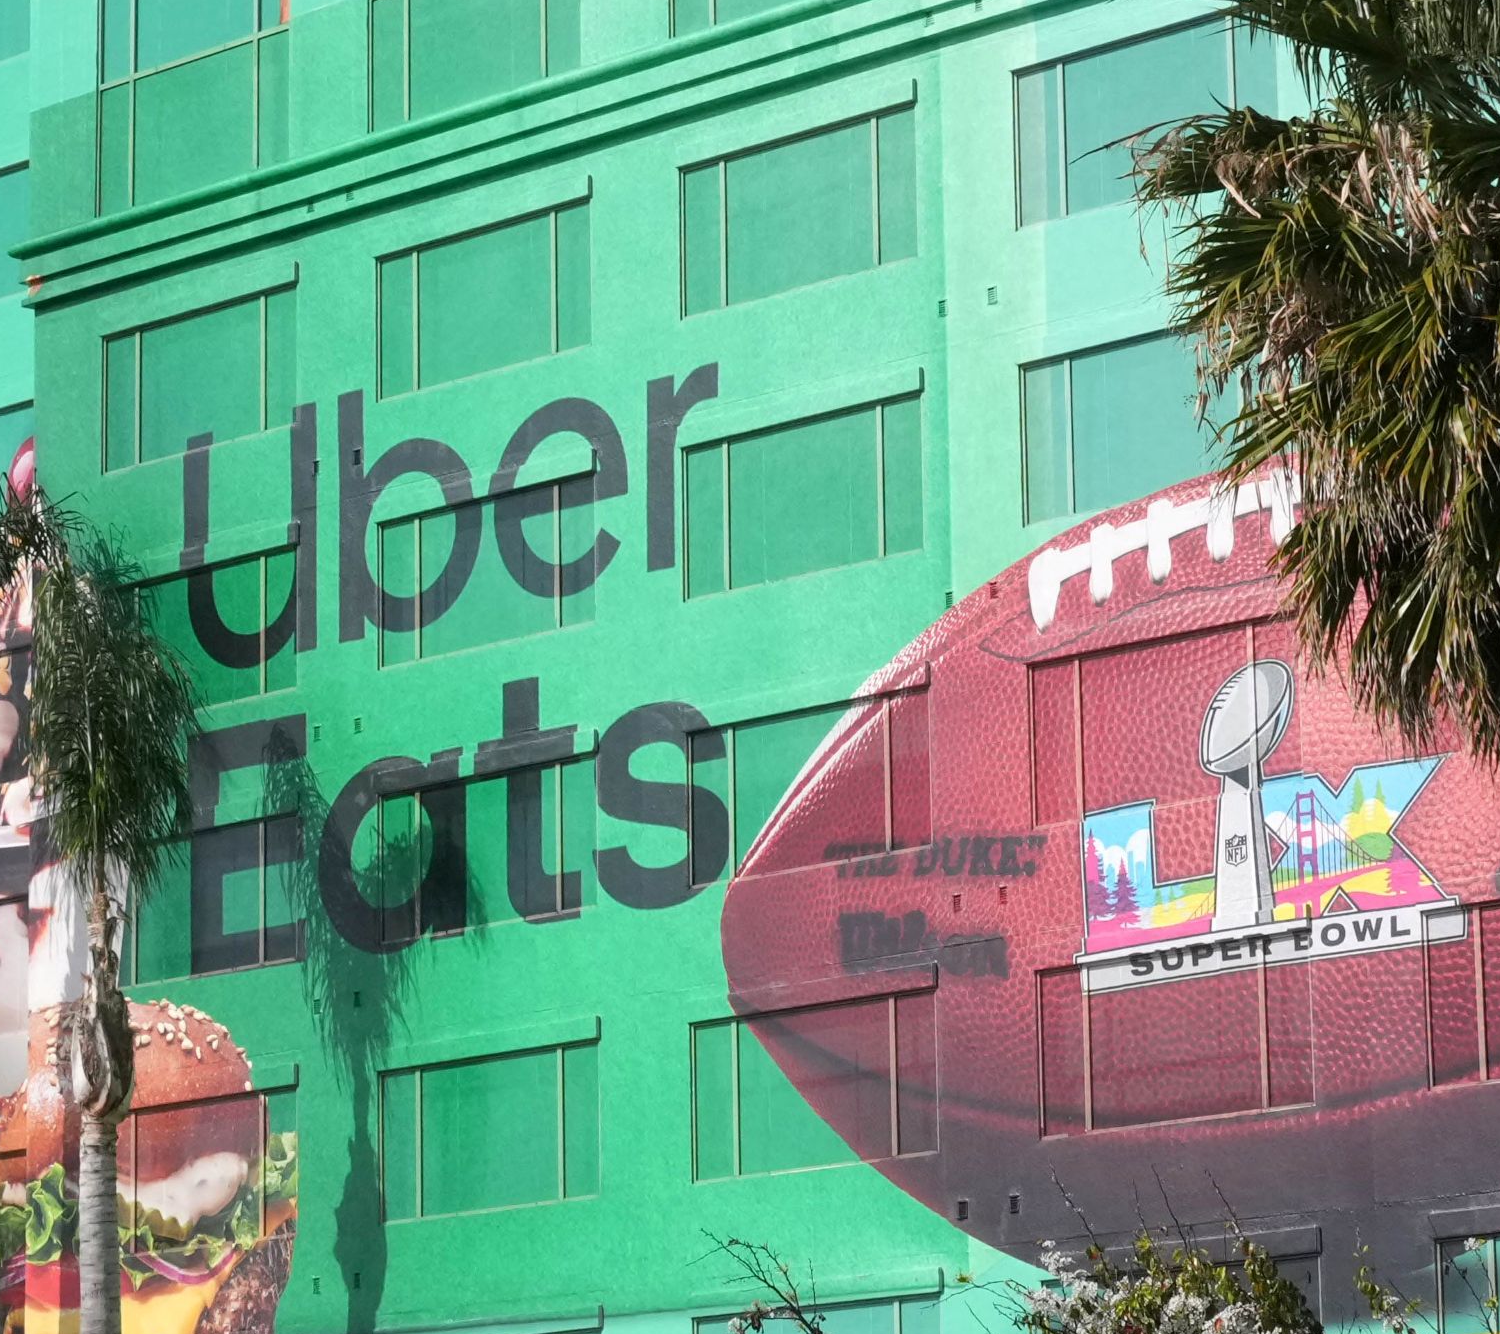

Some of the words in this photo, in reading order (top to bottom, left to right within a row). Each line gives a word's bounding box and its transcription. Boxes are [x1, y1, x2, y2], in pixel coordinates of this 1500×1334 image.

[181, 362, 718, 667] Uber
[190, 677, 732, 973] Eats
[1226, 847, 1246, 863] NFL
[1129, 932, 1273, 977] SUPER
[1294, 915, 1412, 951] BOWL
